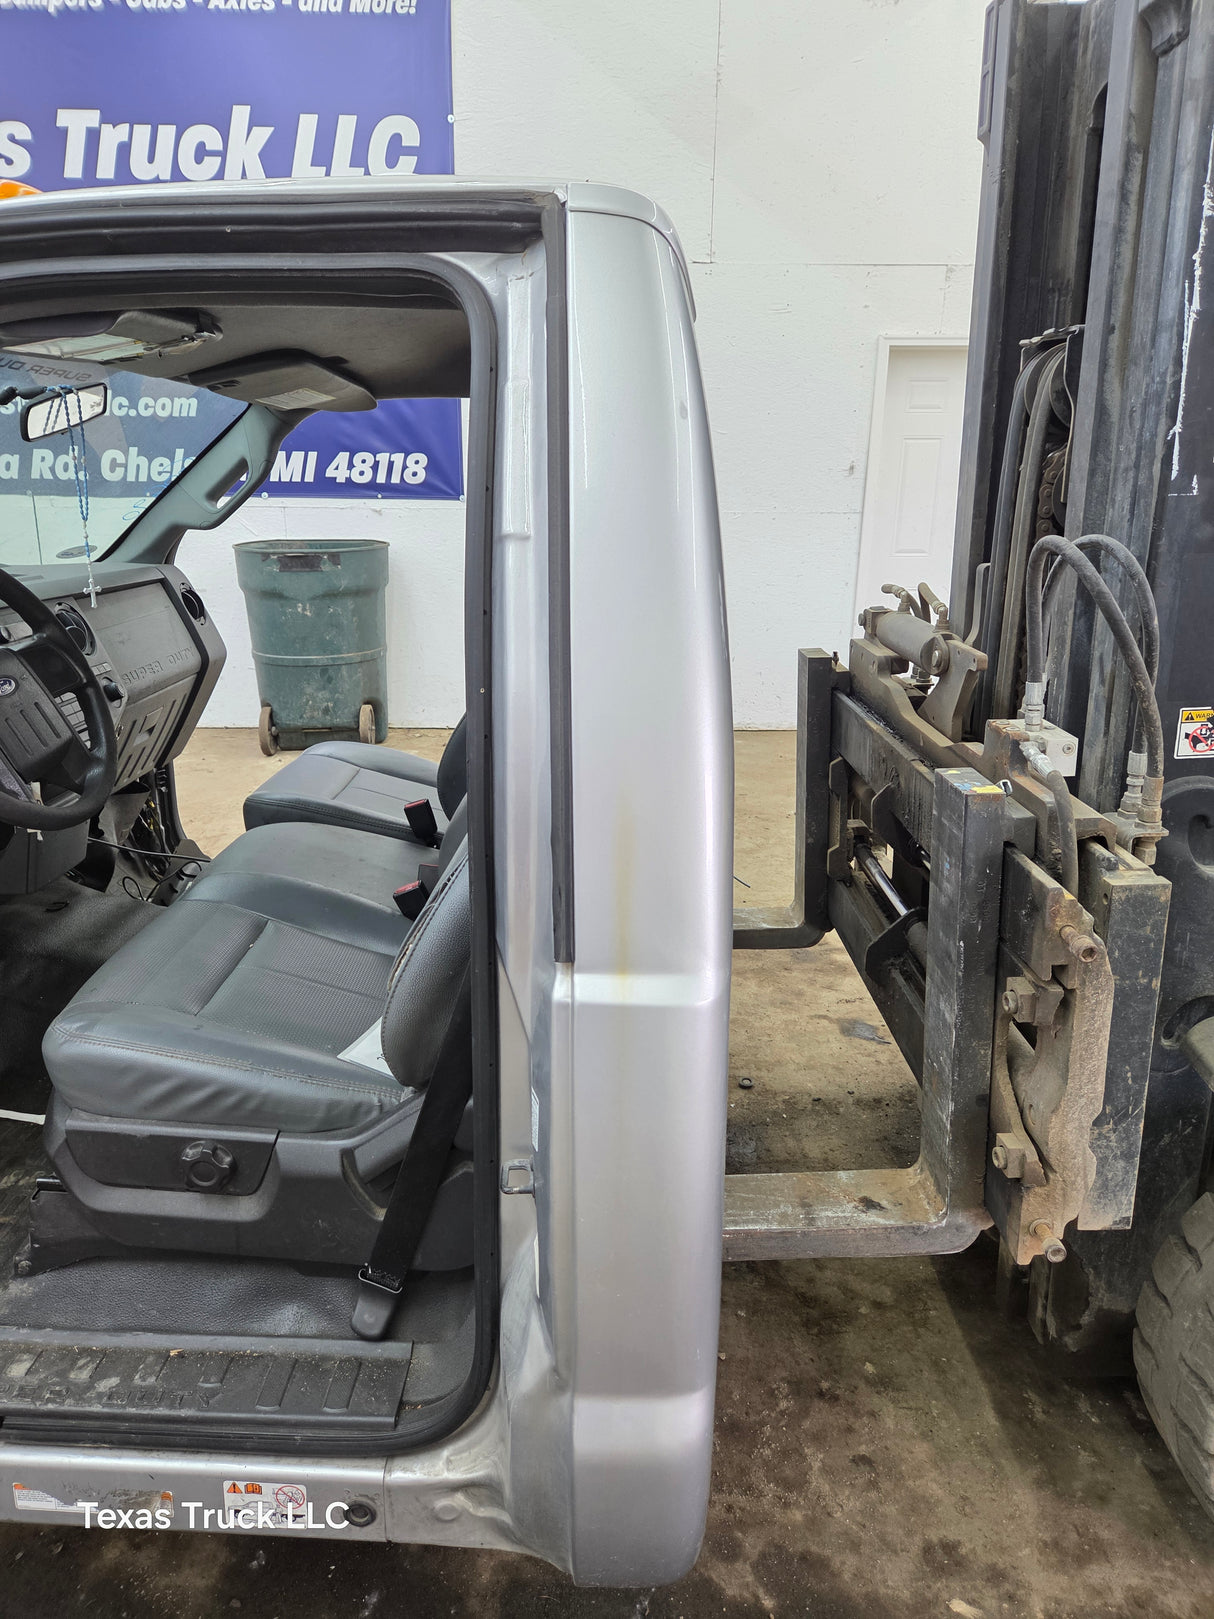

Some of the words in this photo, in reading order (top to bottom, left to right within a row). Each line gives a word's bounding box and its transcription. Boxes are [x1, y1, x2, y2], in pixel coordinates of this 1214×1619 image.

[56, 105, 275, 180] Truck
[291, 113, 421, 177] LLC
[31, 447, 89, 481] Rd.
[269, 451, 318, 482] MI
[325, 451, 428, 485] 48118
